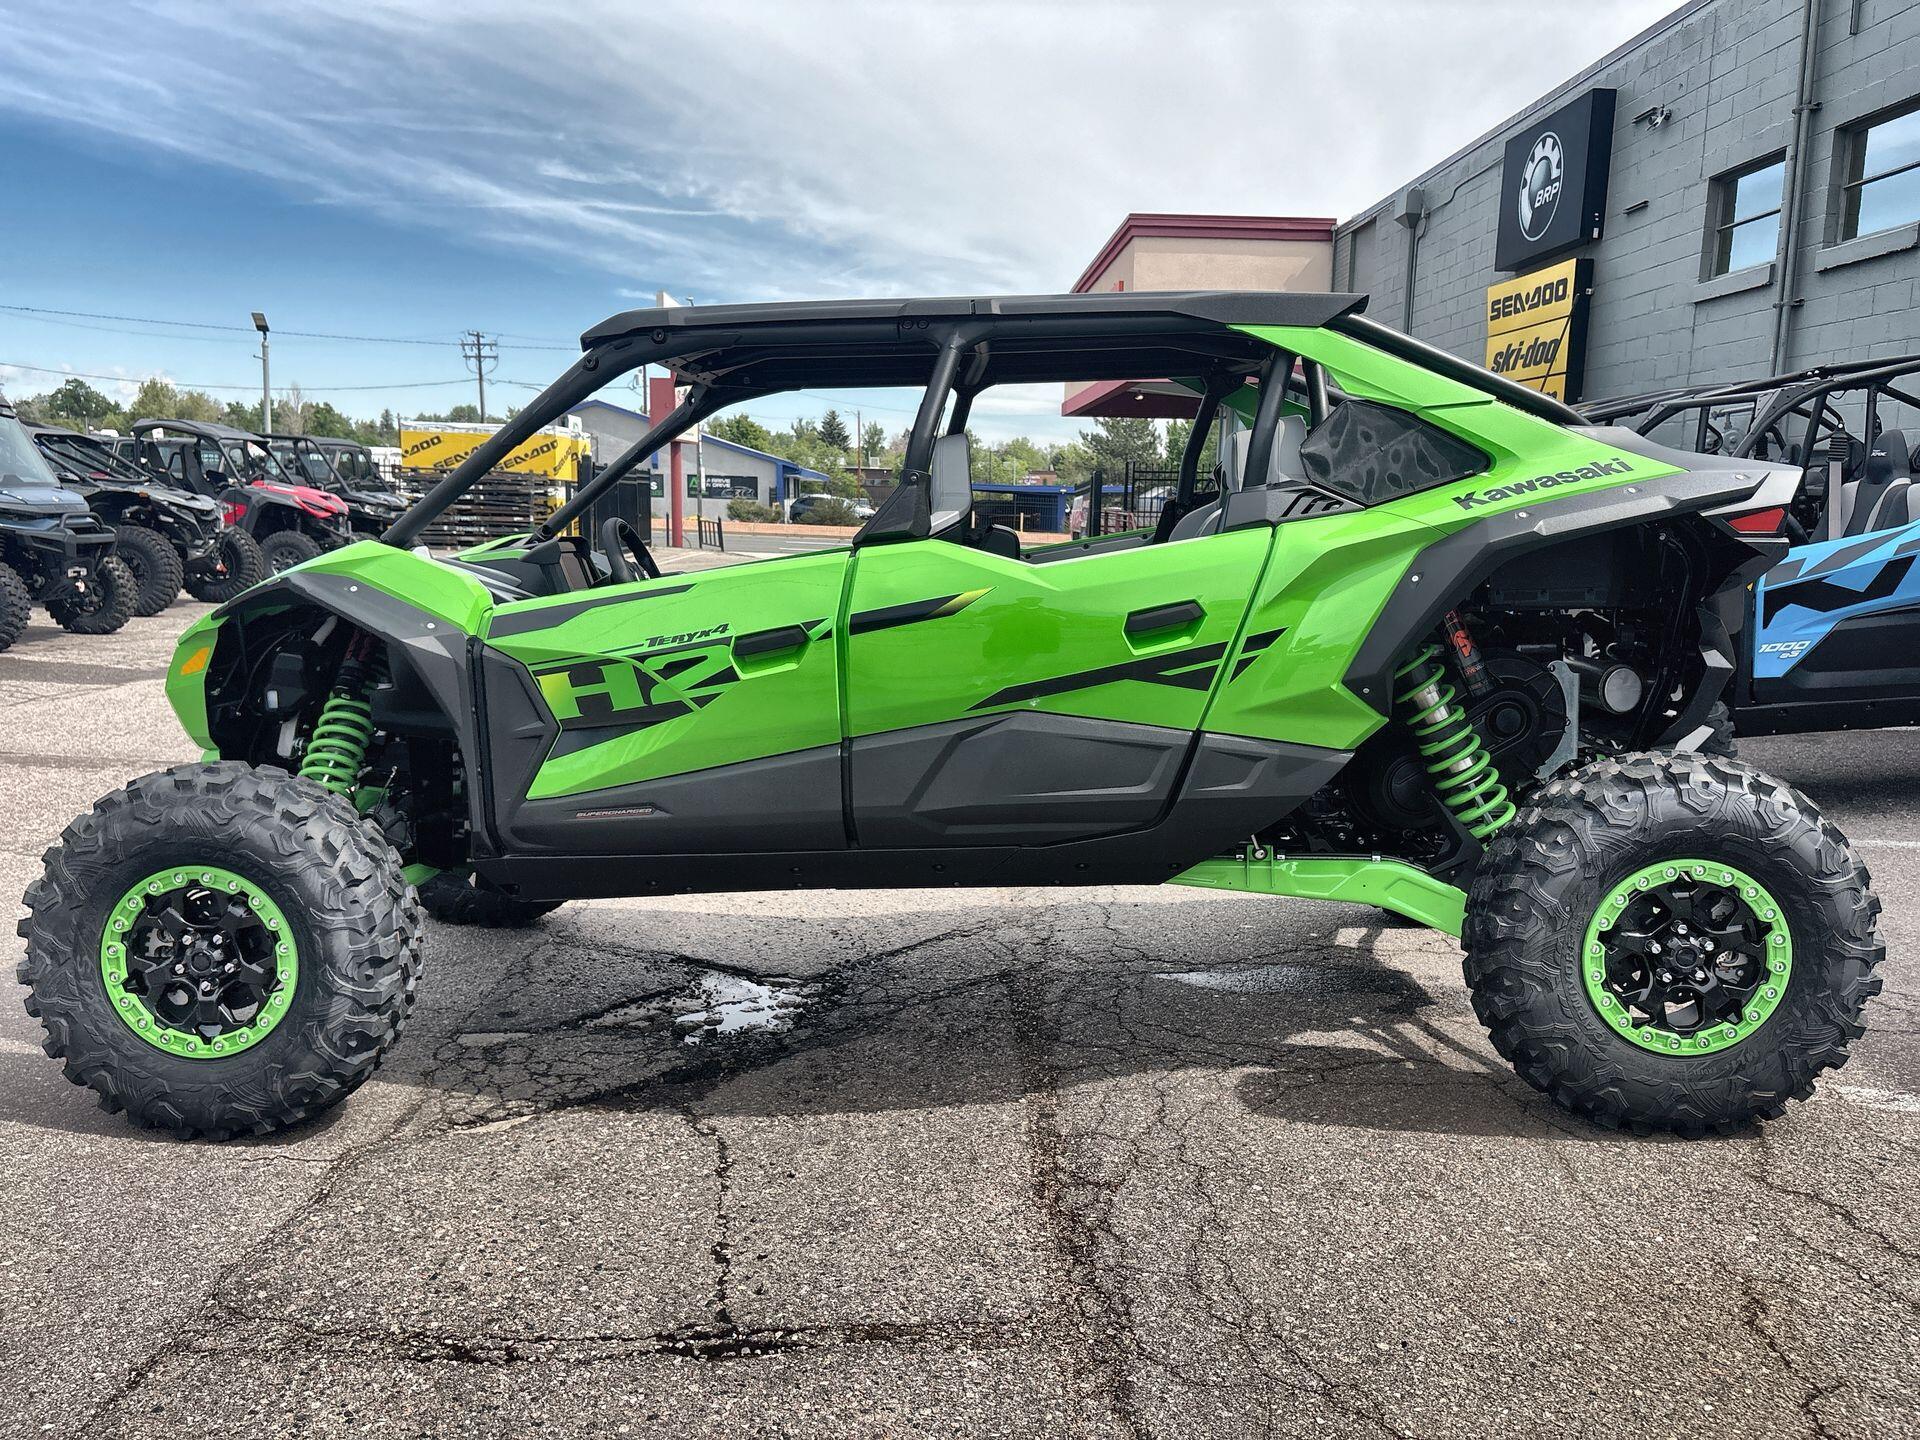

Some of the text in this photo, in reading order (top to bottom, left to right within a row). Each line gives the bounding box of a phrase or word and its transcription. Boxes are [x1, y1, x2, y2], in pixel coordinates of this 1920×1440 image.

[1534, 181, 1560, 208] BRP
[1451, 457, 1634, 511] Kawasaki
[1758, 640, 1812, 653] 1000
[536, 644, 742, 720] H2
[576, 807, 653, 818] SUPERCHARGED
